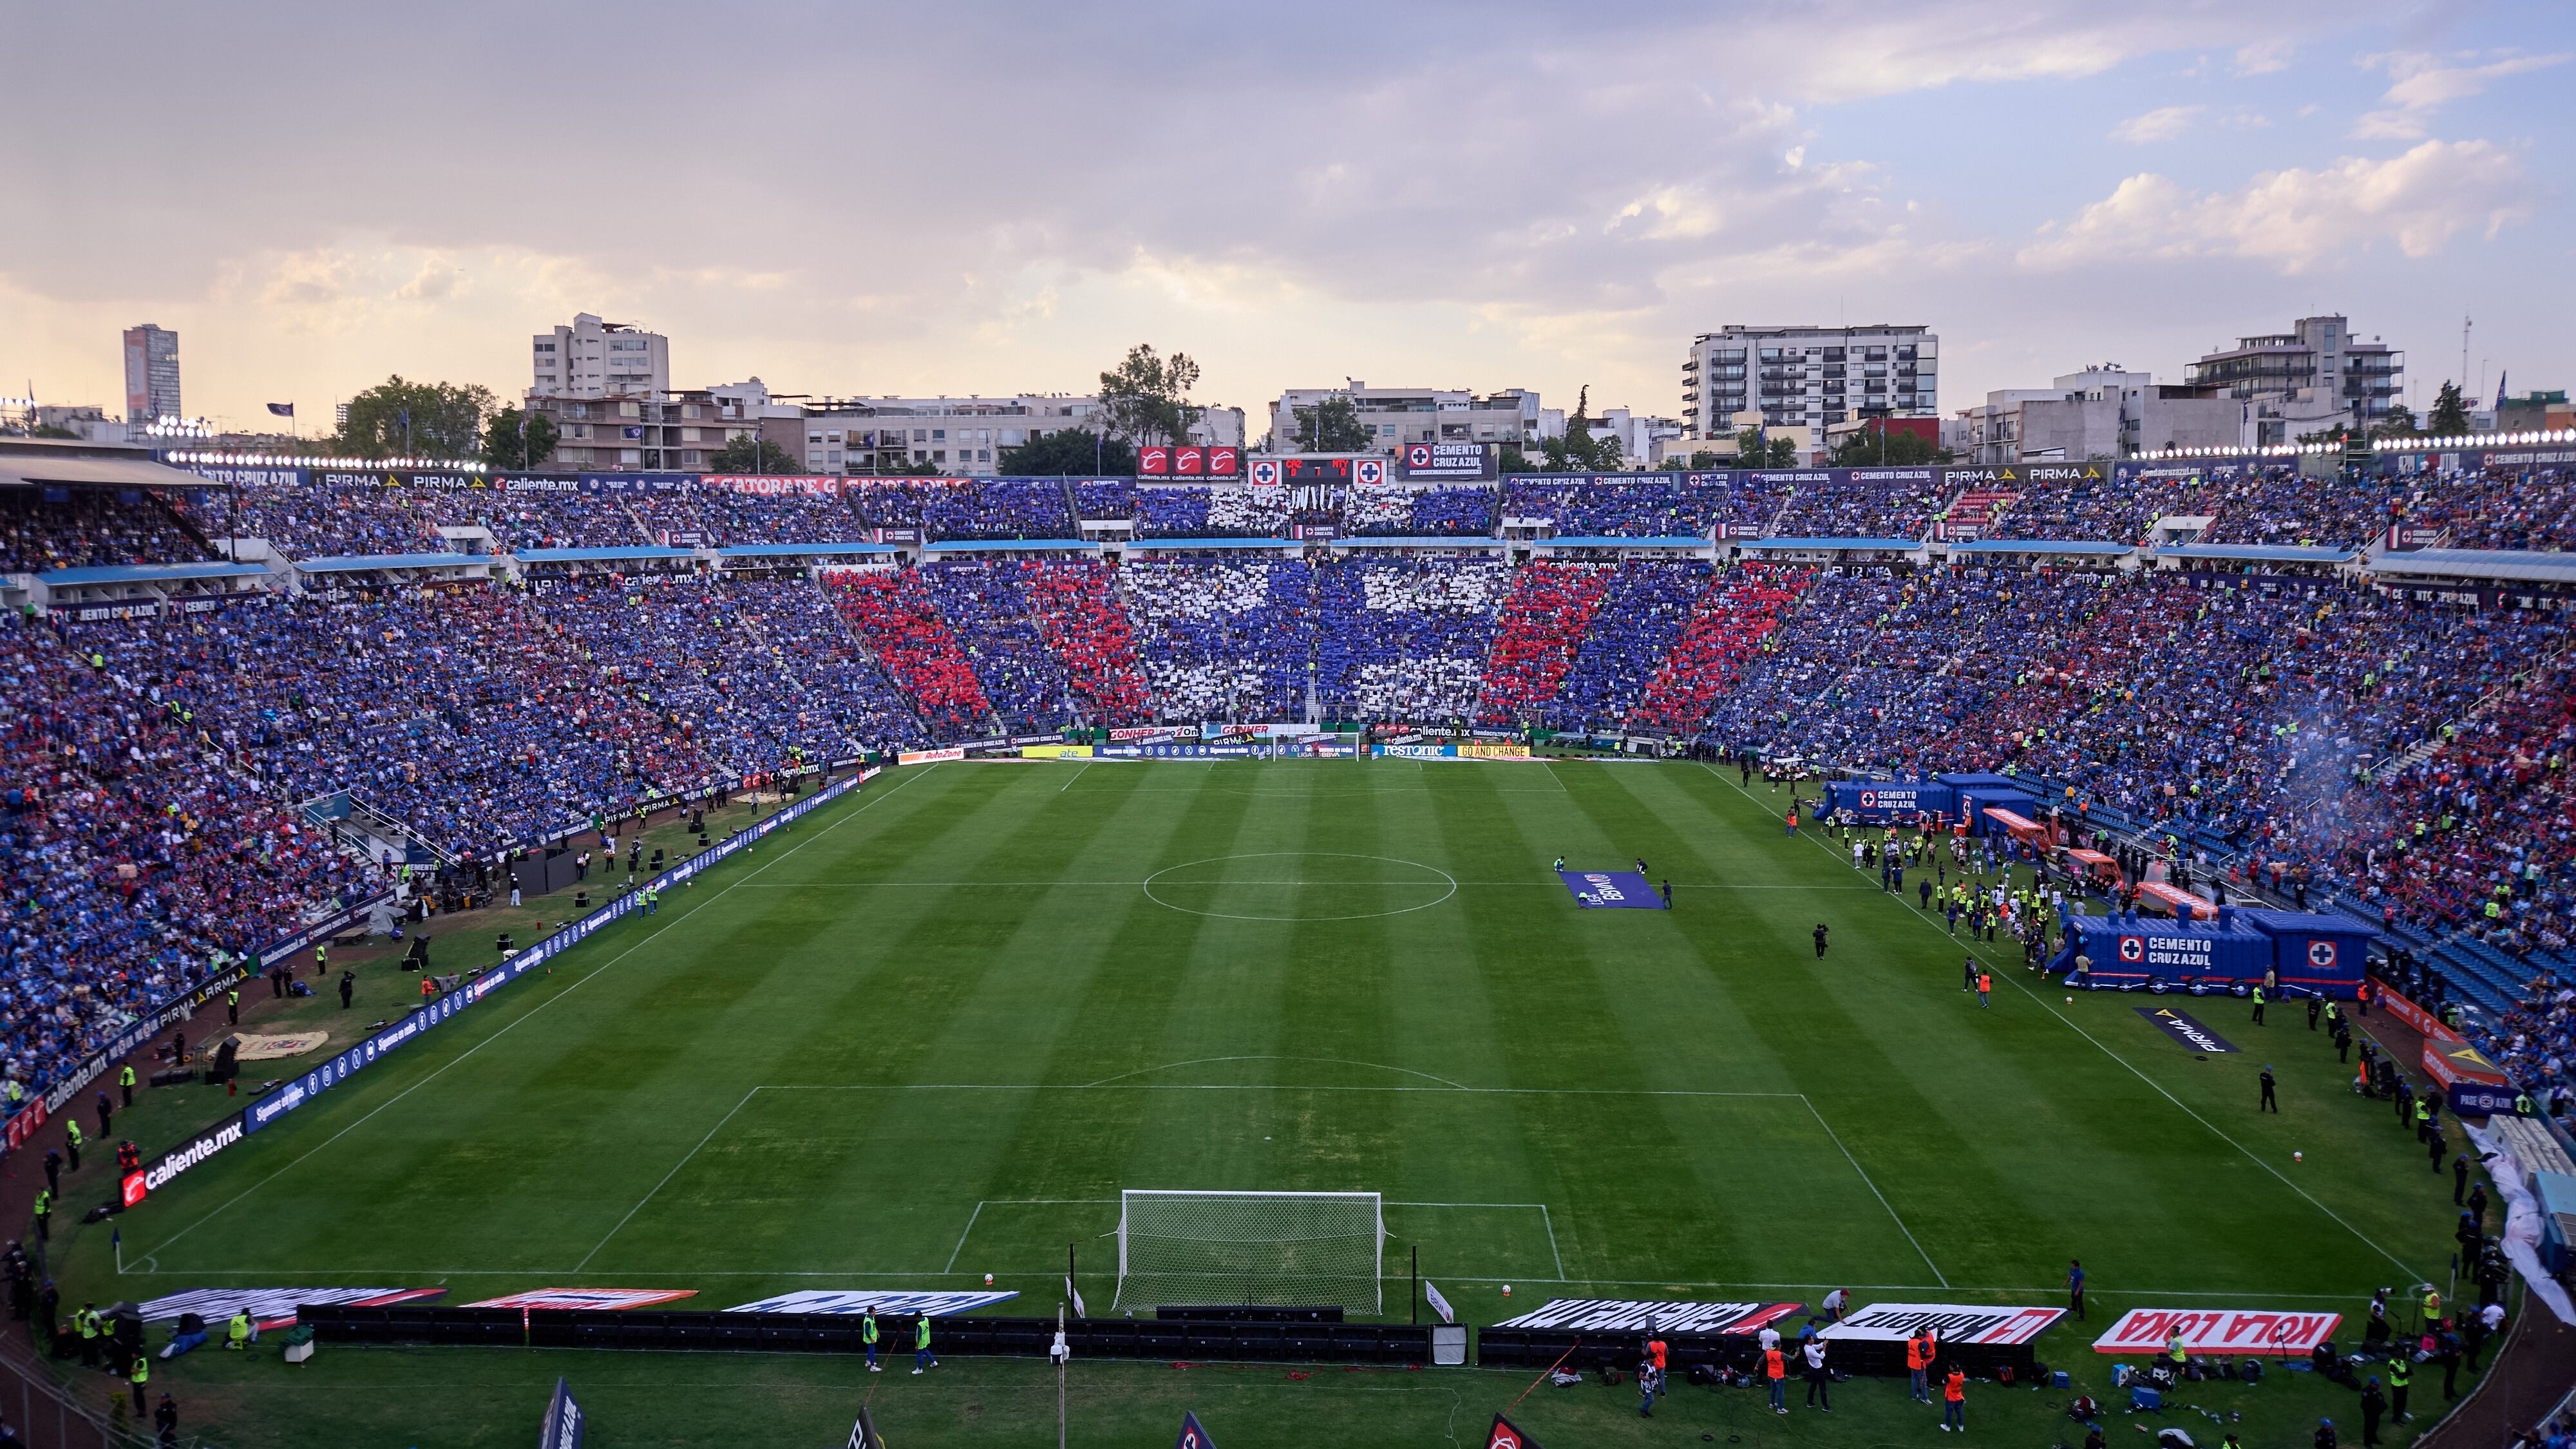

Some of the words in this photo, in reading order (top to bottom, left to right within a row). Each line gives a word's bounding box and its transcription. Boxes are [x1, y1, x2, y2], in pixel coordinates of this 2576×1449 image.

[1433, 445, 1482, 455] CEMENTO
[2494, 453, 2534, 464] CEMENTO
[1861, 471, 1895, 480] CEMENTO
[1945, 471, 1996, 482] PIRMA
[2030, 468, 2081, 479] PIRMA
[326, 474, 381, 488] PIRMA
[413, 476, 467, 488] PIRMA
[506, 478, 578, 491] caliente.mx
[824, 478, 837, 493] G
[1832, 565, 1893, 578] PRMA
[65, 609, 109, 622] CENTO
[1110, 728, 1155, 739] GONHER
[1222, 726, 1269, 735] GONHER
[1213, 735, 1245, 745] PIRMA
[1392, 733, 1423, 745] caliente.mx
[924, 750, 961, 761] AutoZone
[1463, 747, 1473, 757] GO
[1475, 747, 1490, 757] AND
[1493, 747, 1525, 757] CHANGE
[1878, 791, 1917, 800] CEMENTO
[643, 803, 670, 813] PIRMA
[1592, 882, 1625, 900] BBVA
[2148, 937, 2211, 952] CEMENTO
[2148, 952, 2179, 965] CRUZ
[2181, 953, 2211, 966] AZUL
[160, 998, 196, 1027] PIRMA
[404, 1023, 416, 1036] redes
[2168, 1019, 2226, 1052] PIRMA
[46, 1053, 108, 1115] caliente.mx
[281, 1095, 289, 1107] en
[289, 1087, 304, 1103] redes
[2460, 1094, 2477, 1106] PASE
[2495, 1097, 2512, 1108] AZUL
[145, 1121, 243, 1191] caliente.mx
[1430, 1293, 1446, 1316] BBVA
[1492, 1299, 1759, 1332] caliente.mx
[1843, 1312, 2012, 1343] Koblenz
[2114, 1312, 2224, 1343] LOKA
[2223, 1314, 2327, 1344] KOLA
